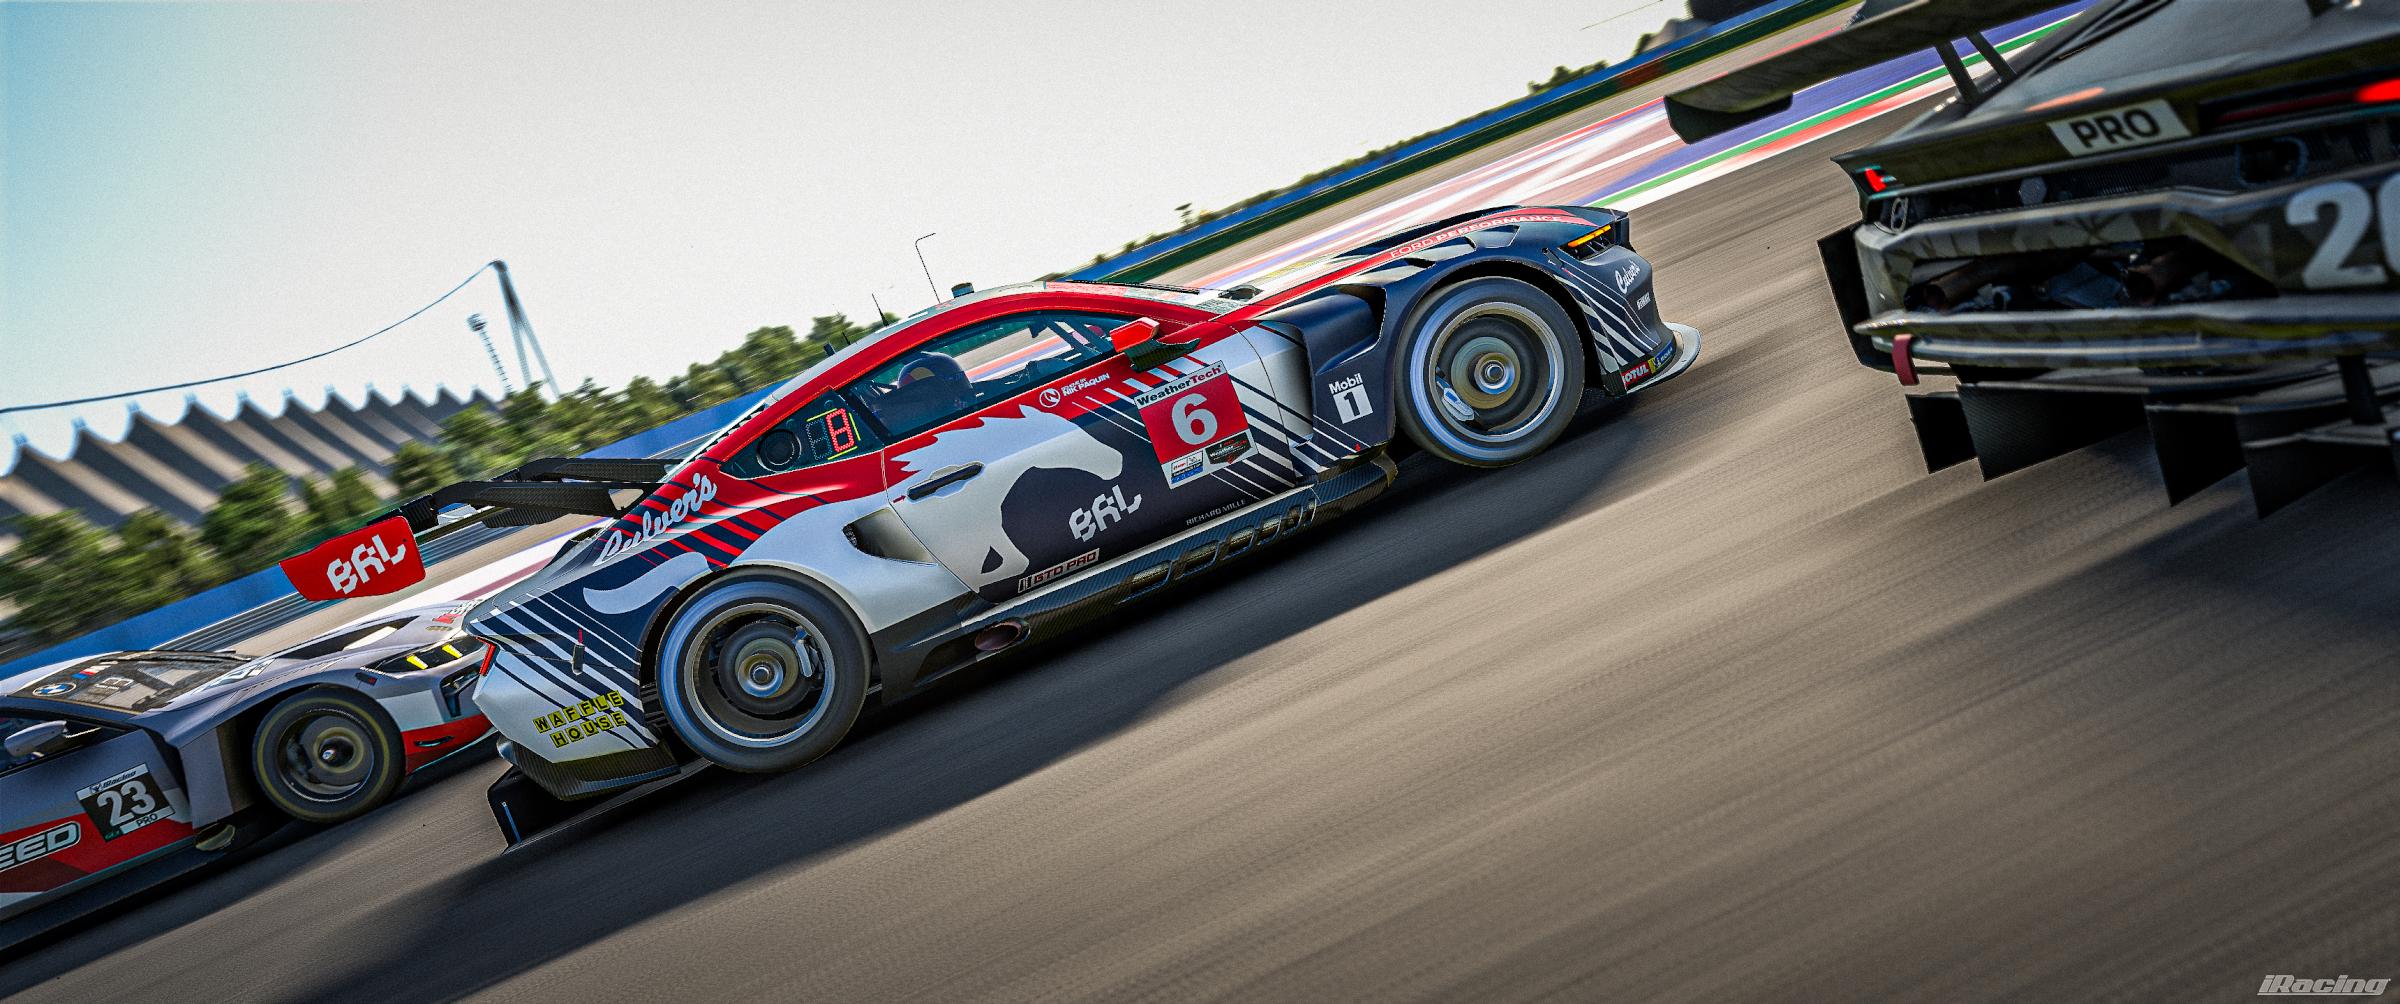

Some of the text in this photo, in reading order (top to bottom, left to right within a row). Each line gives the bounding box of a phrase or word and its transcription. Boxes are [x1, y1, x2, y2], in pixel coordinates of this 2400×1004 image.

[2069, 109, 2160, 148] PRO
[1391, 215, 1562, 258] FORD PERFORMANCE
[1079, 373, 1110, 390] PAQUIN
[1137, 365, 1221, 406] WeatherTech
[1329, 373, 1363, 394] Mobil
[1172, 393, 1218, 445] 6
[1344, 392, 1361, 416] 1
[592, 473, 717, 567] Culver's
[1186, 499, 1246, 526] RICHARD MILLE
[1066, 551, 1096, 570] PRO
[533, 690, 624, 733] WAFFLE
[550, 711, 627, 748] HOUSE
[97, 780, 155, 826] 23
[136, 813, 158, 827] PRO
